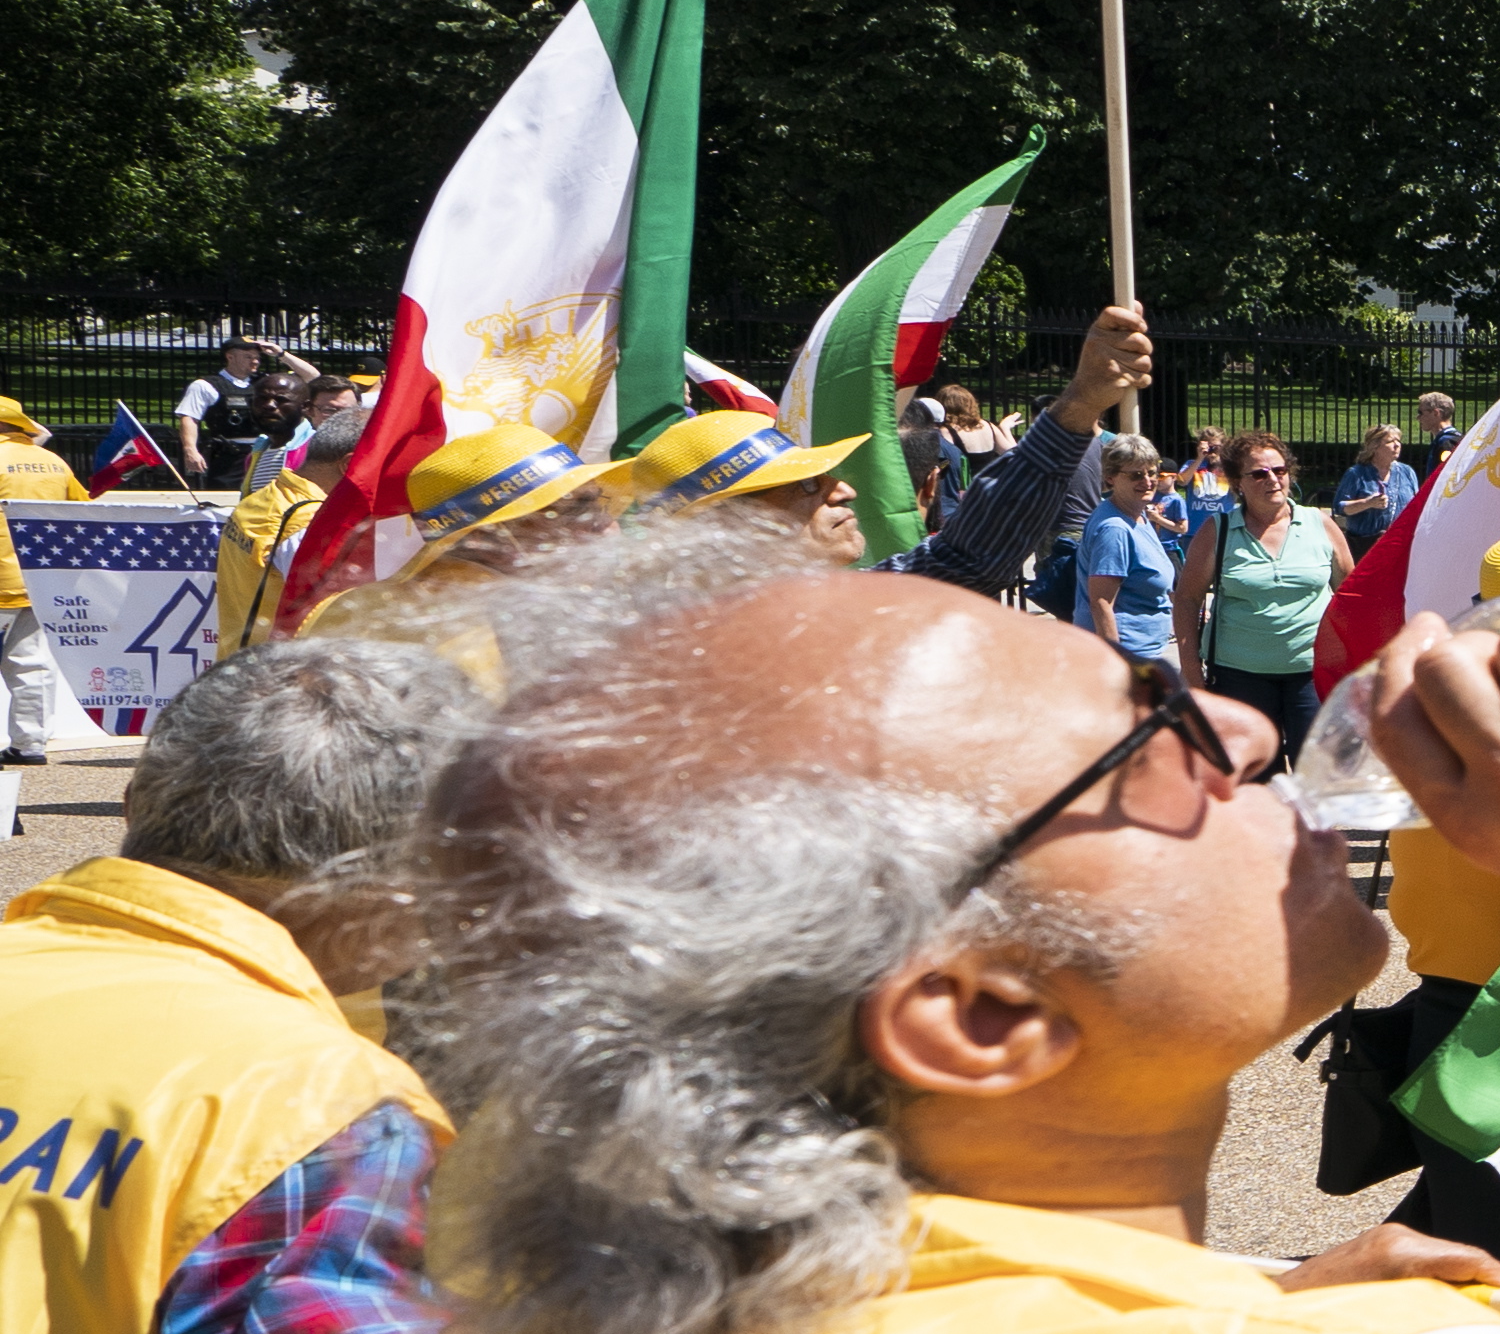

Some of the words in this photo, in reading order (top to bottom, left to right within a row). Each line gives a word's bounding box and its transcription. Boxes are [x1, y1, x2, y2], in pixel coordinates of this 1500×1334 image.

[1192, 500, 1225, 513] NASA
[54, 595, 91, 608] Safe
[62, 608, 88, 620] All
[43, 621, 108, 635] Nations
[58, 635, 99, 648] Kids
